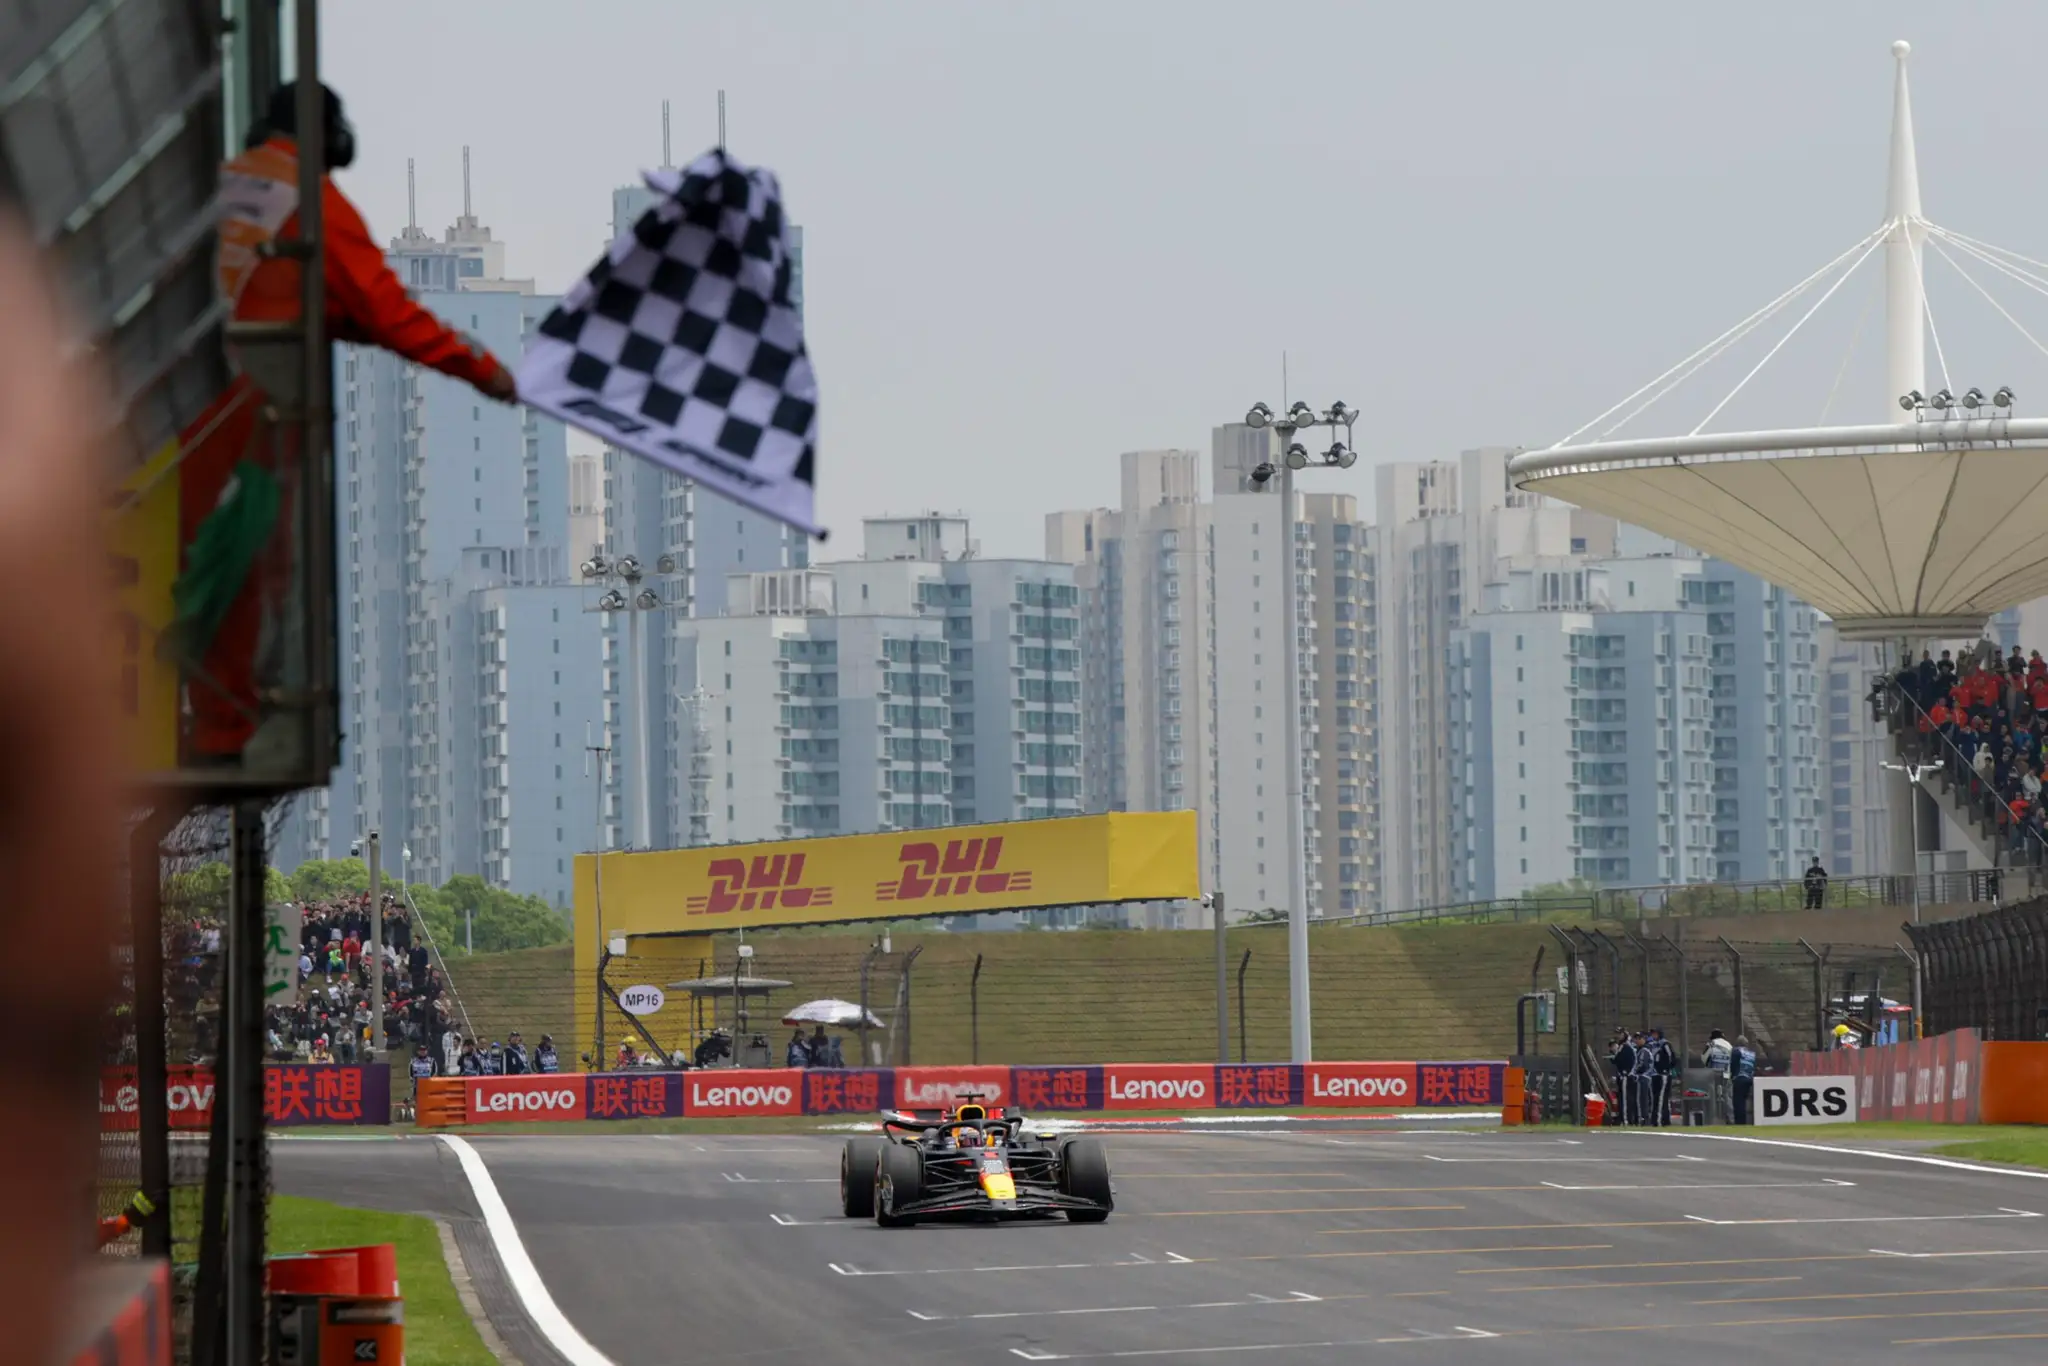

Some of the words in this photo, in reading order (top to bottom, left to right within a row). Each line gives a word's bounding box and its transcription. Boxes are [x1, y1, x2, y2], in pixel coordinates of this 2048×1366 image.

[705, 853, 814, 914] DHL
[897, 836, 1012, 900] DHL
[625, 993, 659, 1006] MP16
[264, 1067, 362, 1121] 联想
[475, 1088, 576, 1113] Lenovo
[592, 1076, 667, 1116] 联想
[692, 1083, 792, 1107] Lenovo
[808, 1072, 880, 1111] 联想
[904, 1077, 1002, 1103] Lenovo
[1018, 1070, 1088, 1109] 联想
[1110, 1075, 1206, 1100] Lenovo
[1220, 1066, 1290, 1105] 联想
[1313, 1073, 1408, 1098] Lenovo
[1422, 1065, 1491, 1103] 联想
[1762, 1086, 1848, 1118] DRS
